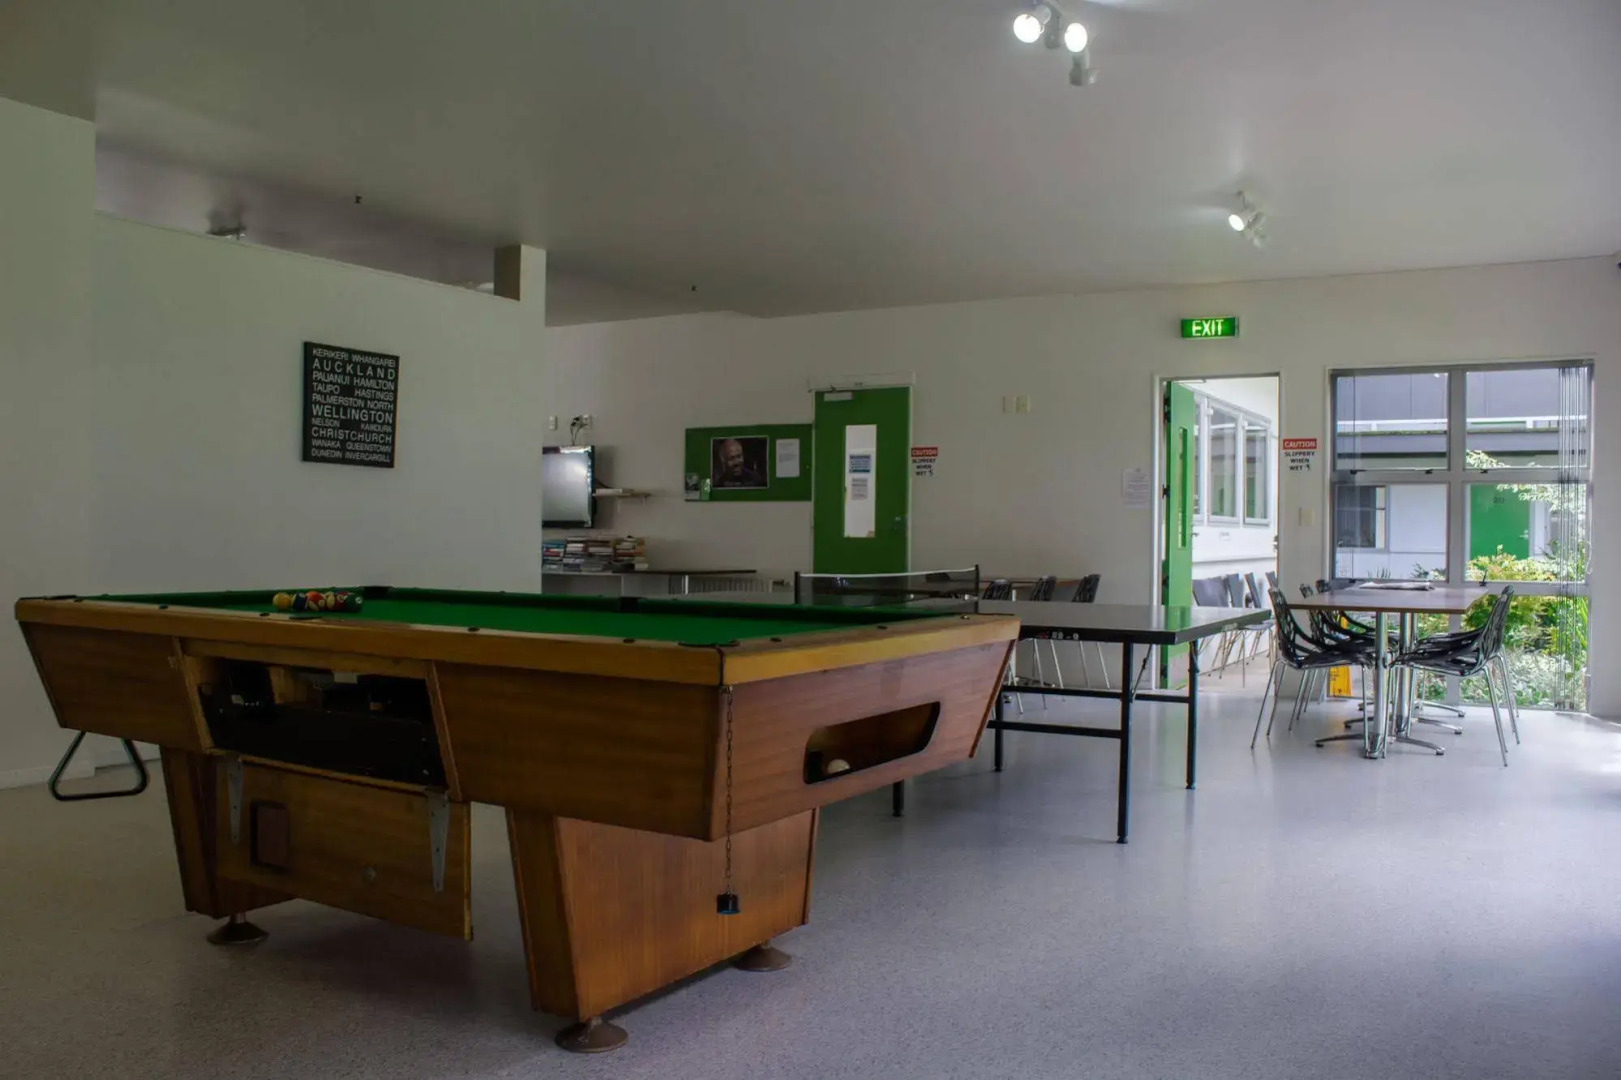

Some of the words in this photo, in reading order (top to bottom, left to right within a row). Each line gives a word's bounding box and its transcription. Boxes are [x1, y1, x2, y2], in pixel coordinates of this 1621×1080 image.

[1192, 319, 1224, 336] EXIT
[312, 347, 348, 360] KERIKERI
[352, 353, 395, 367] WHANGAREI
[312, 358, 395, 379] AUCKLAND
[312, 382, 340, 394] TAUPO
[354, 388, 394, 401] HASTINGS
[353, 377, 394, 390] HAMILTON
[312, 393, 364, 407] PALMERSTON
[367, 400, 393, 410] NORTH
[312, 404, 392, 423] WELLINGTON
[311, 418, 340, 427] NELSON
[360, 423, 392, 432] KAIKOURA
[311, 426, 392, 443] CHRISTCHURCH
[311, 438, 340, 448] WANAKA
[346, 441, 392, 452] QUEENSTOWN
[1284, 440, 1316, 448] CAUTION
[311, 448, 343, 458] DUNEDIN
[345, 450, 390, 462] INVERCARGILL
